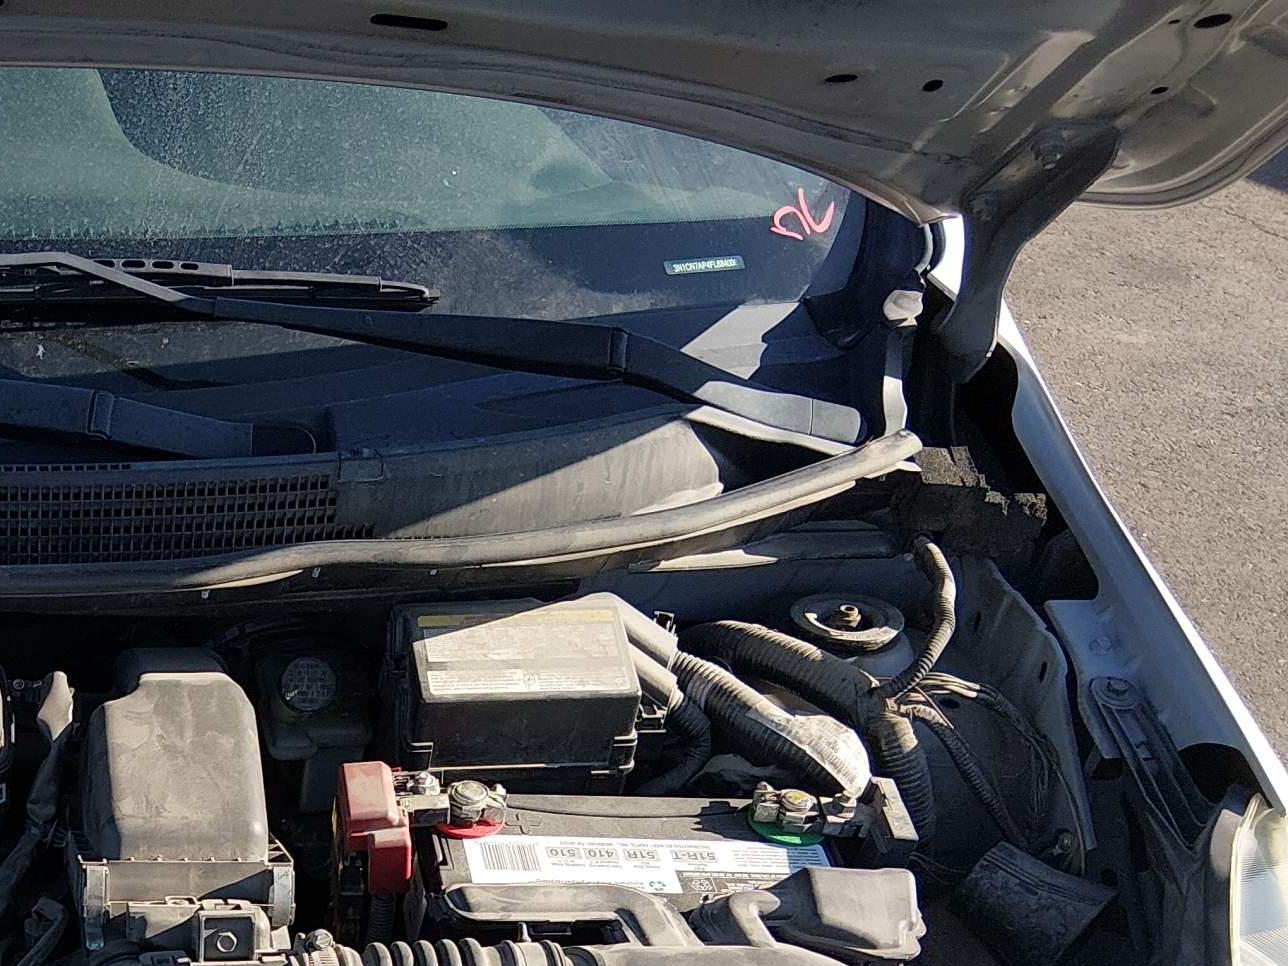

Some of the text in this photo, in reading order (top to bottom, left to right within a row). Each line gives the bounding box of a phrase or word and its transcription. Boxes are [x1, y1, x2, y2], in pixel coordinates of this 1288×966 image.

[550, 848, 576, 857] 510
[588, 848, 614, 858] 410
[627, 849, 656, 860] 51R
[672, 850, 716, 861] 51R-T
